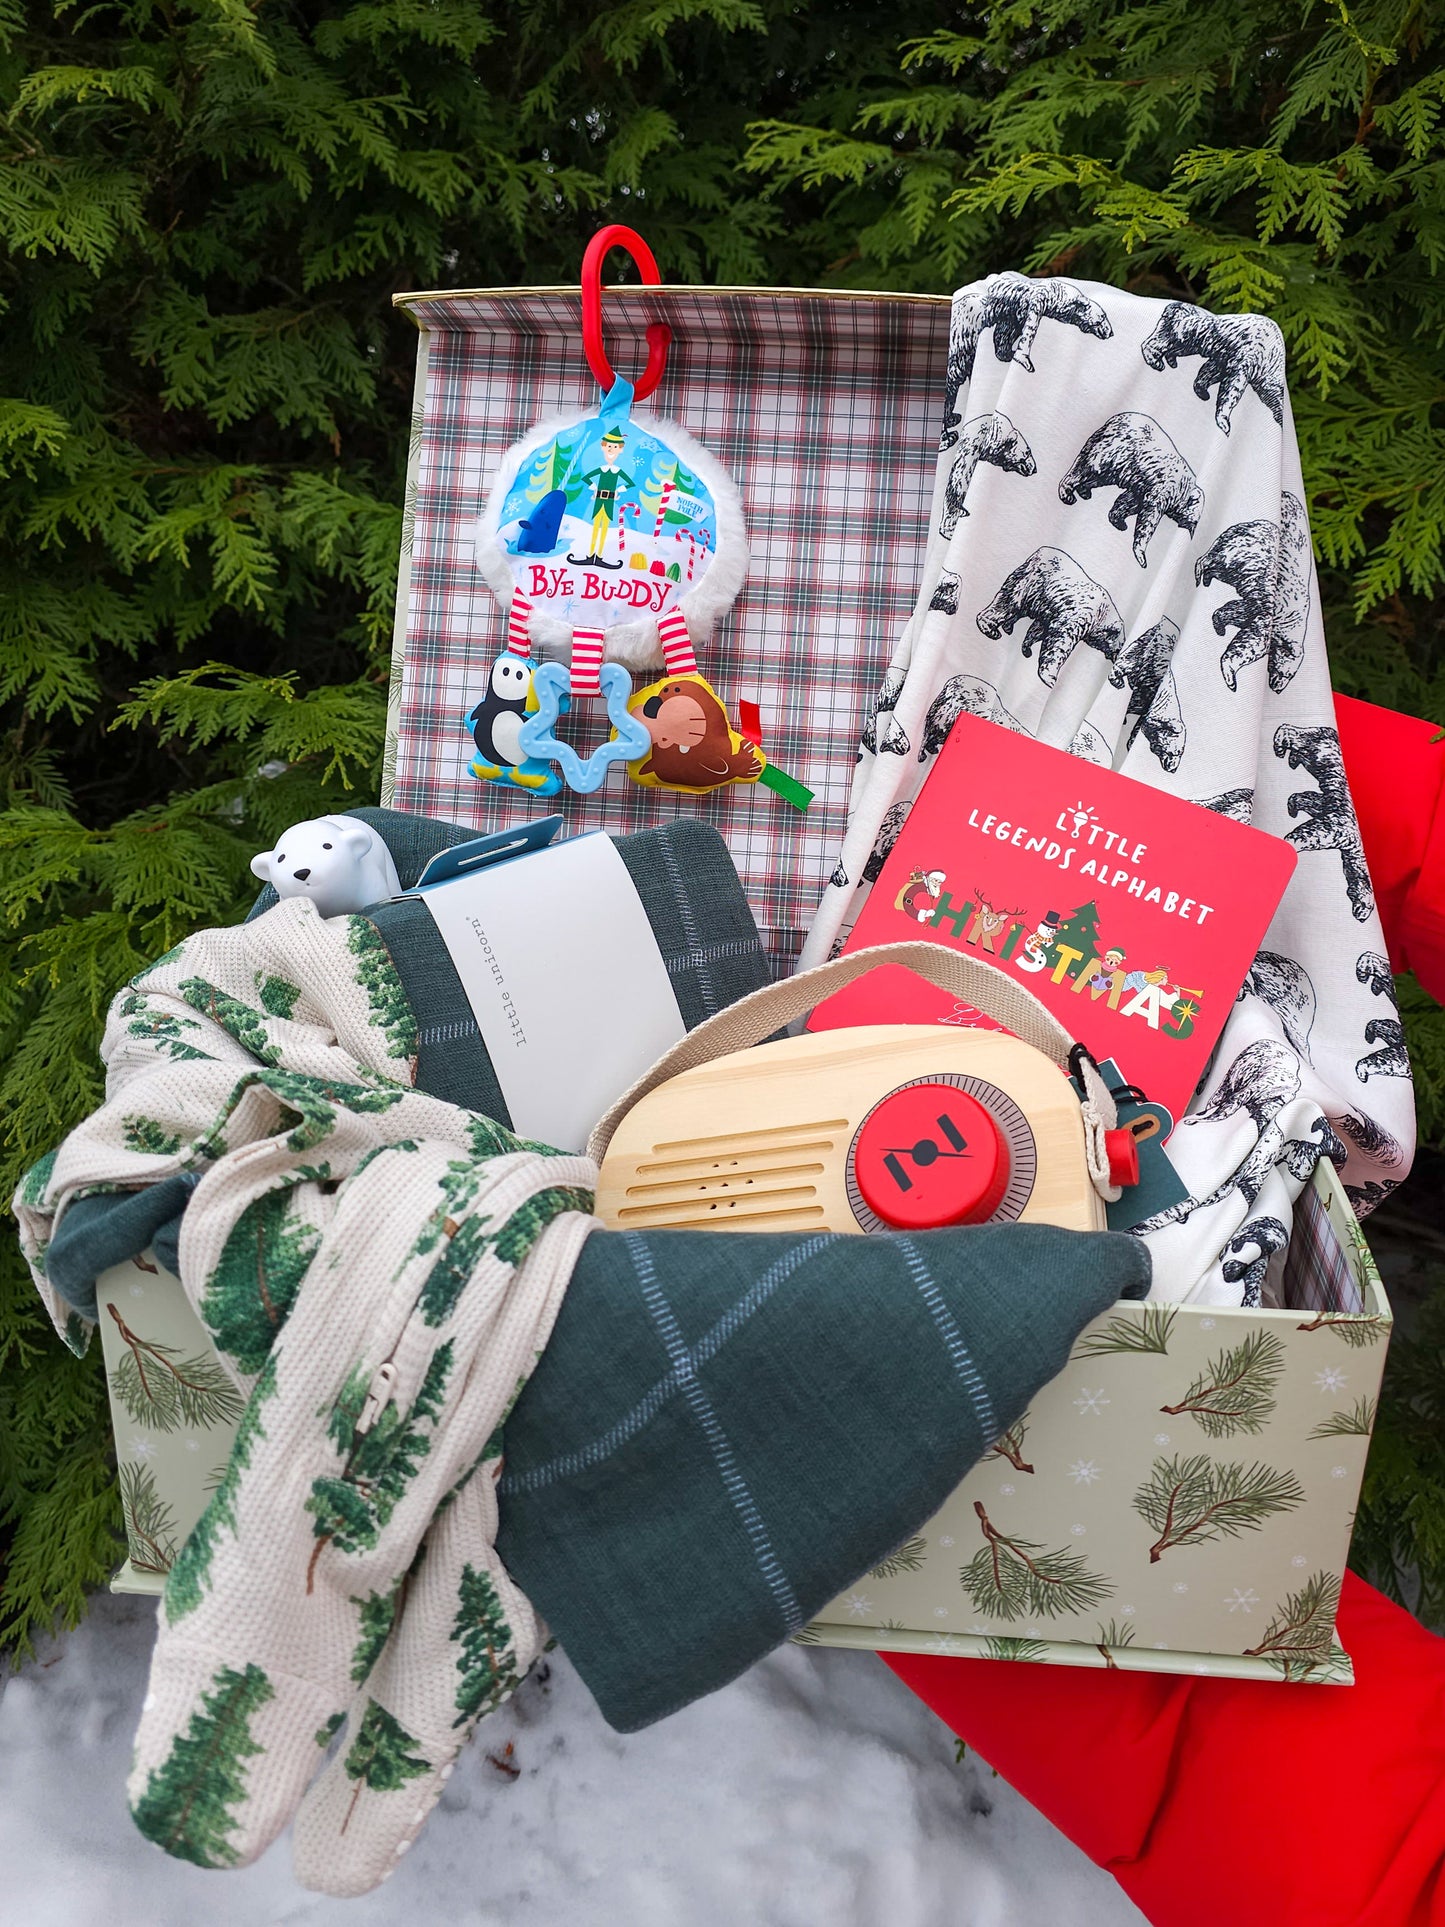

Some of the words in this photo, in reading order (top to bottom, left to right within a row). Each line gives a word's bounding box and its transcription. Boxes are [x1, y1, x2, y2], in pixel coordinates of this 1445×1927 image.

[676, 496, 704, 514] NORTH
[677, 504, 697, 518] POLE
[528, 564, 575, 598] BYE
[580, 572, 673, 612] BUDDY
[967, 808, 1077, 870] LEGENDS
[1080, 859, 1215, 926] ALPHABET
[894, 868, 1205, 1041] CHRISTMAS
[501, 991, 527, 1048] little
